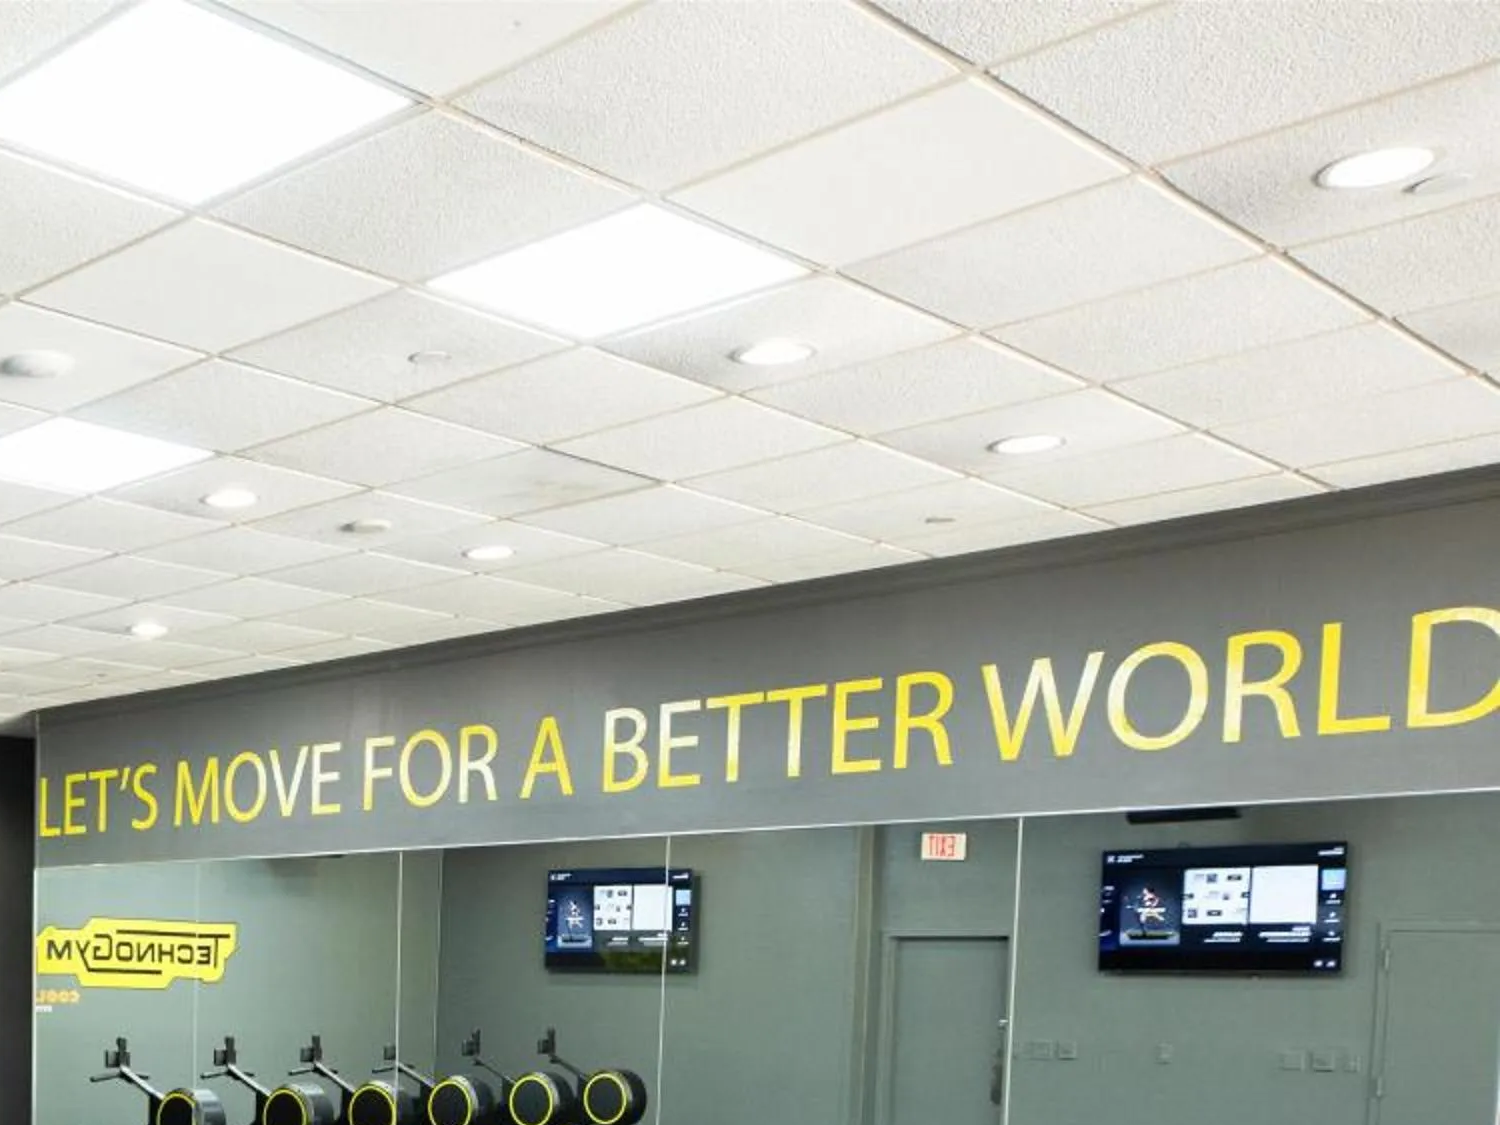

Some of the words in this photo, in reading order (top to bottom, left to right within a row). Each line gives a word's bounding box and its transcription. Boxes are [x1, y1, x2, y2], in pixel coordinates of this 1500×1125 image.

[39, 763, 157, 837] LET'S
[173, 741, 342, 826] MOVE
[363, 724, 498, 811] FOR
[519, 715, 573, 799] A
[602, 670, 954, 794] BETTER
[982, 606, 1500, 762] WORLD
